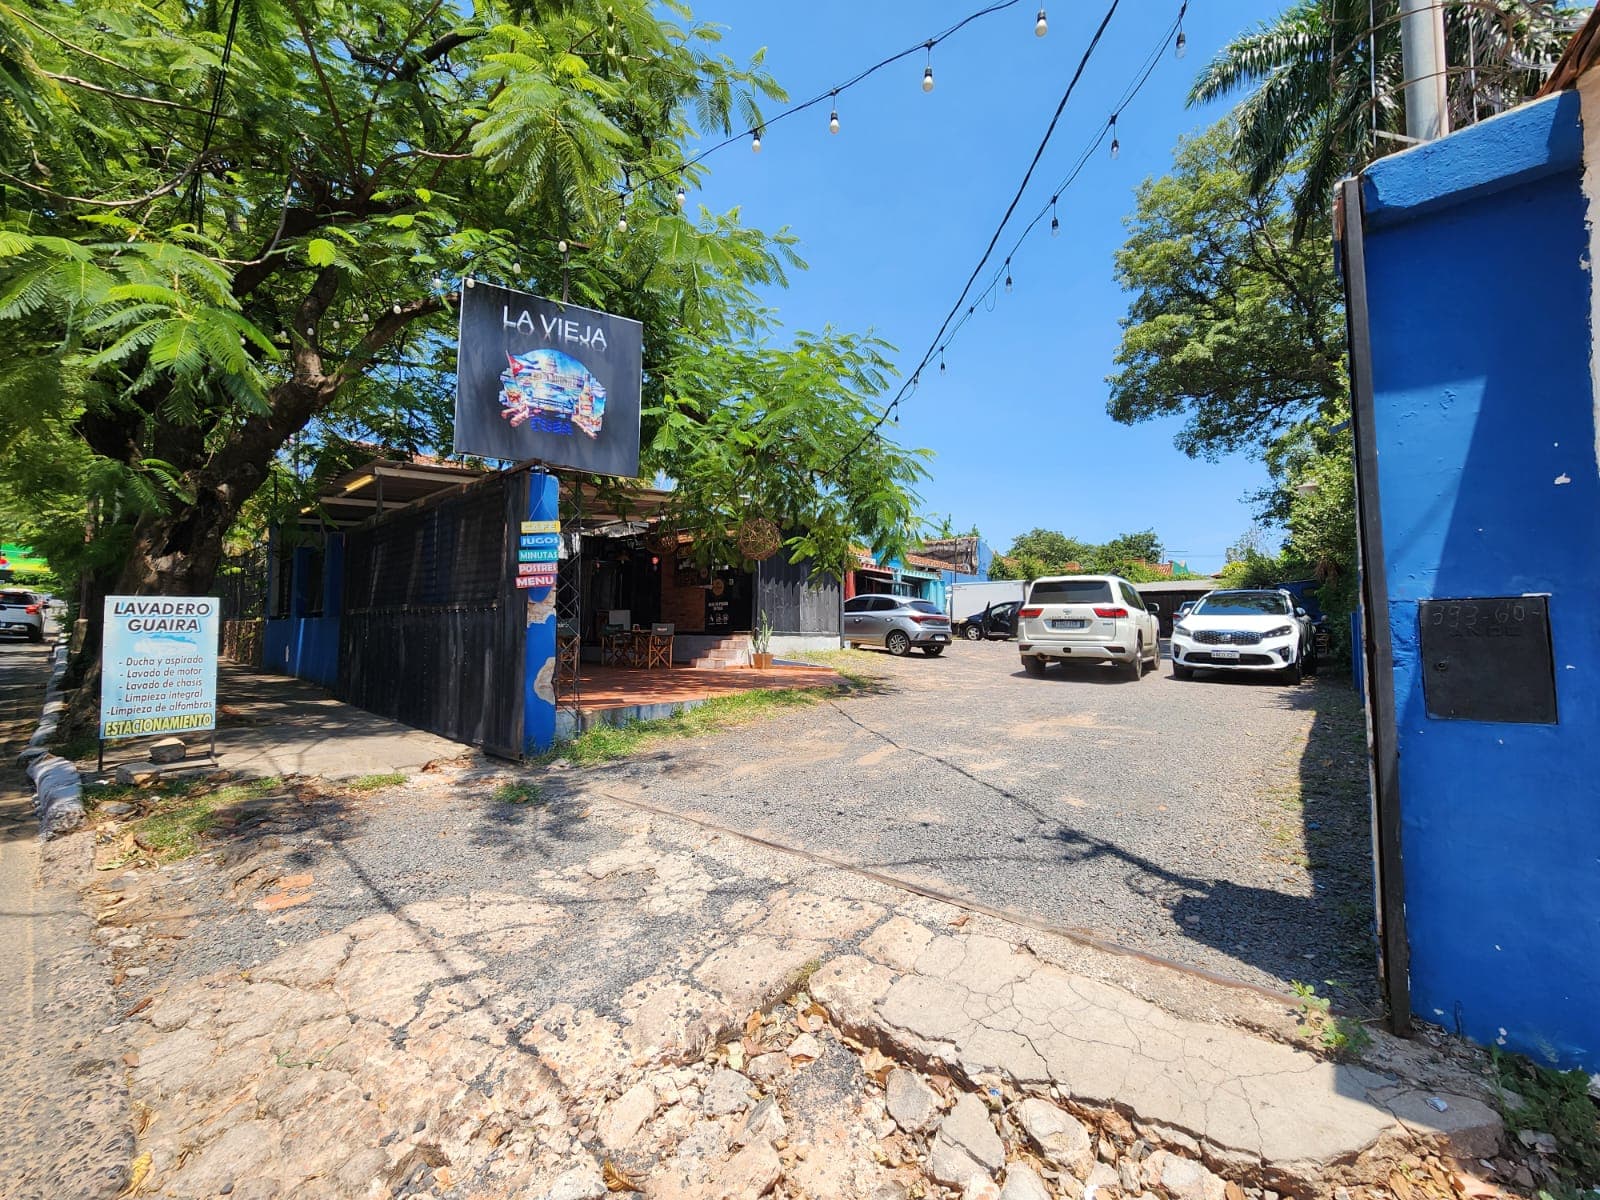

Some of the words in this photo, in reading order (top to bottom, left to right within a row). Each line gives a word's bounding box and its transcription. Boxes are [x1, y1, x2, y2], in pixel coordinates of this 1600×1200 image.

[502, 305, 535, 331] LA
[540, 313, 608, 348] VIEJA
[522, 536, 559, 546] JUGOS
[519, 551, 558, 561] MINUTAS
[518, 563, 557, 573] POSTRES
[515, 576, 554, 588] MENU
[114, 602, 210, 615] LAVADERO
[127, 618, 199, 632] GUAIRA
[126, 657, 155, 666] Ducha
[157, 659, 163, 667] y
[165, 655, 204, 667] aspirado
[127, 668, 161, 679] Lavado
[163, 667, 175, 677] de
[177, 667, 203, 676] motor
[126, 680, 160, 690] Lavado
[162, 679, 174, 688] de
[176, 678, 203, 687] chasis
[125, 693, 166, 704] Limpieza
[169, 688, 203, 700] integral
[155, 703, 167, 712] de
[169, 700, 213, 711] alfombras
[104, 713, 212, 736] ESTACIONAMIENTO
